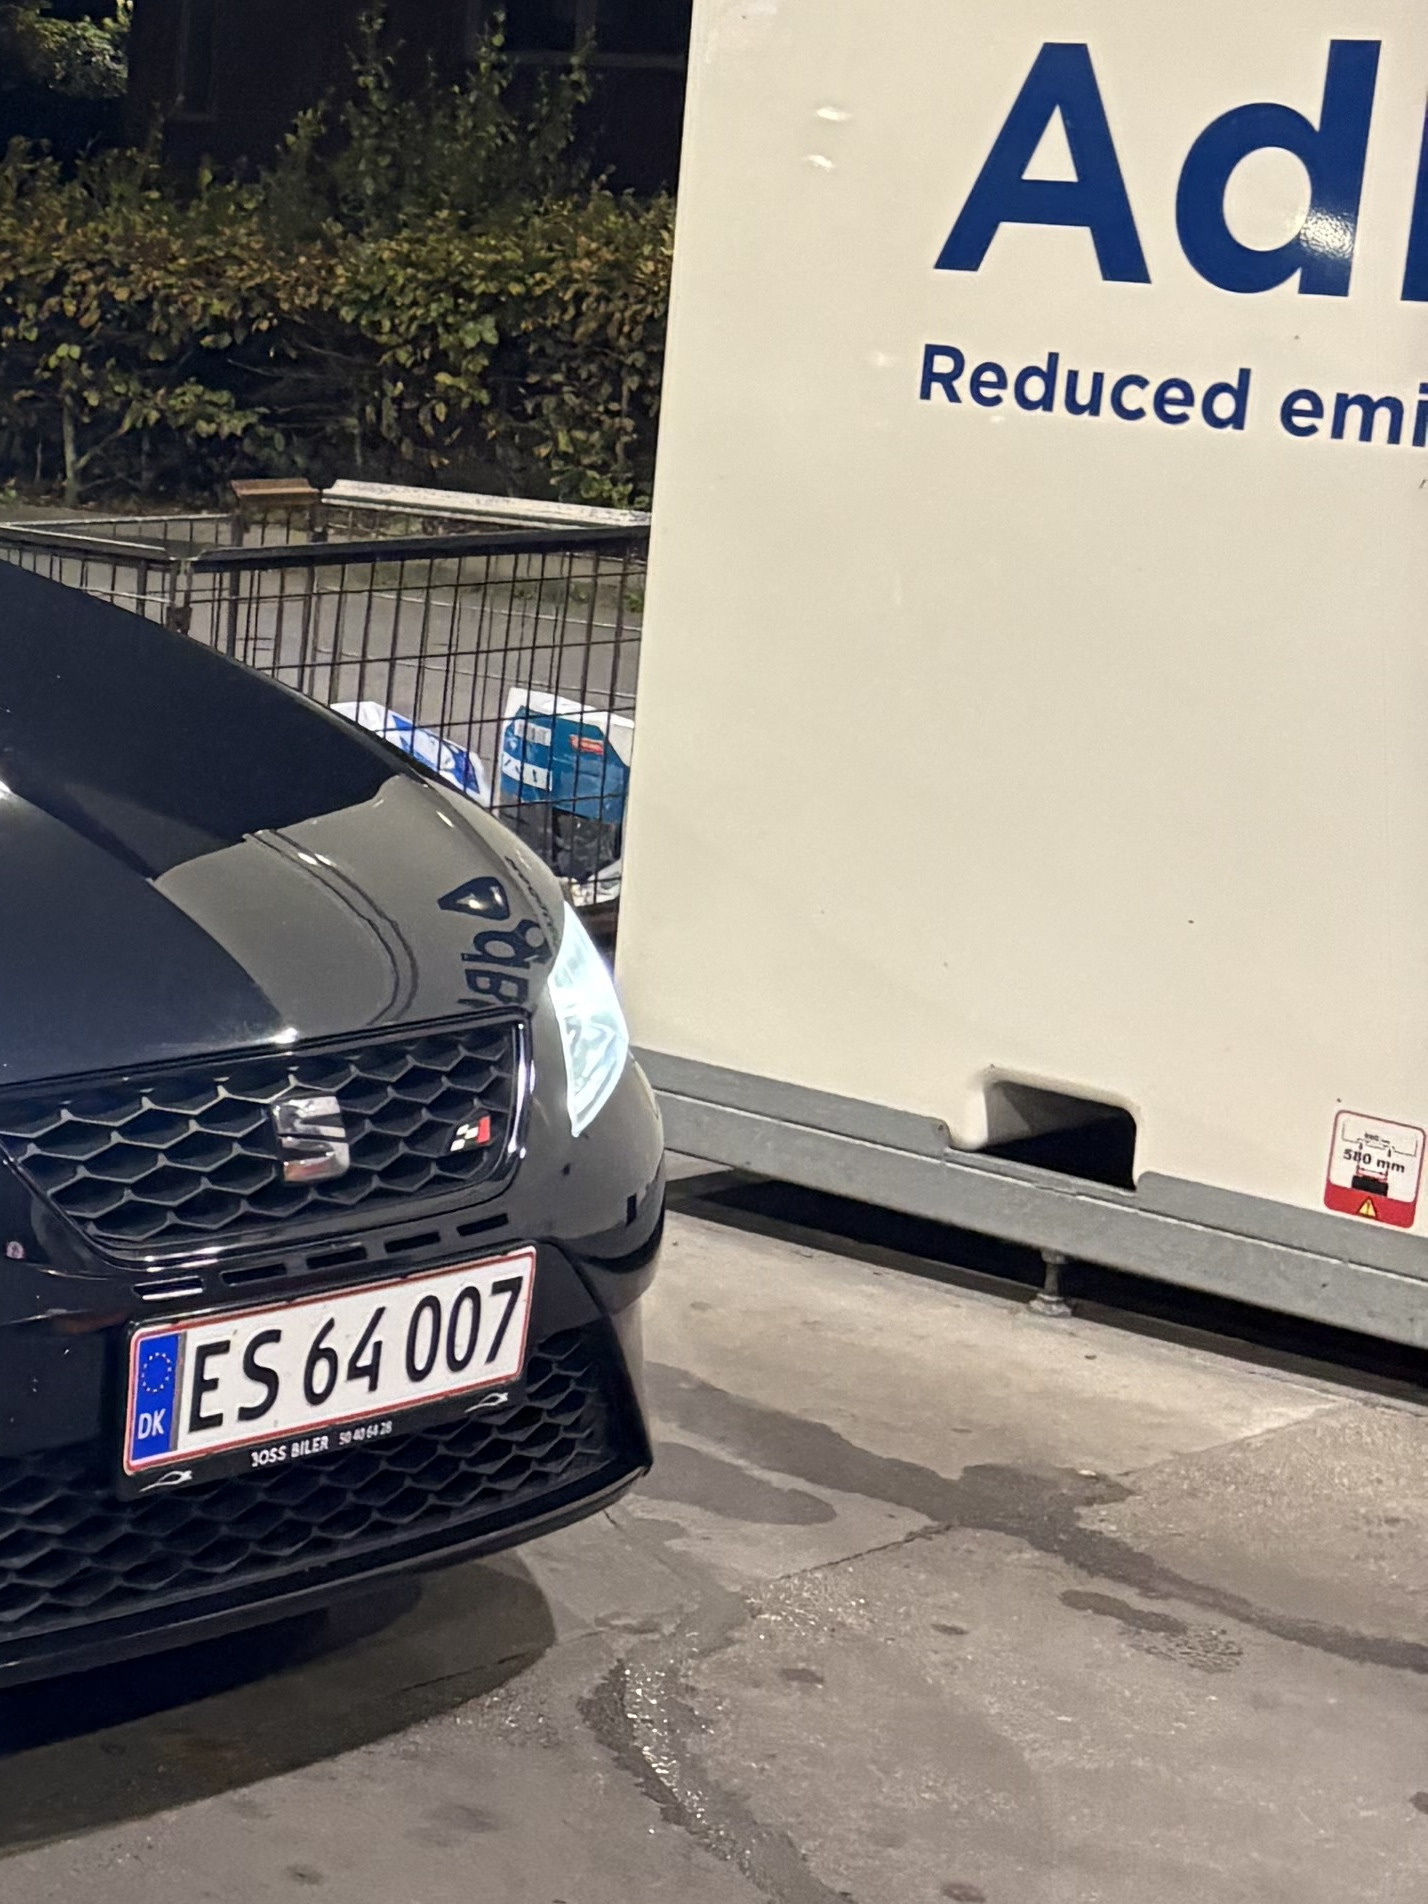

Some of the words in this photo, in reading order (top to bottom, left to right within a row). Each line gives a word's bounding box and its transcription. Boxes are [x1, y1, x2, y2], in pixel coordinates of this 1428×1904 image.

[934, 40, 1428, 302] Ad
[920, 343, 1251, 431] Reduced
[1376, 1159, 1405, 1174] mm
[188, 1329, 282, 1433] ES
[304, 1306, 386, 1406] 64
[405, 1276, 523, 1383] 007
[137, 1409, 166, 1440] DK
[291, 1435, 329, 1457] BILER
